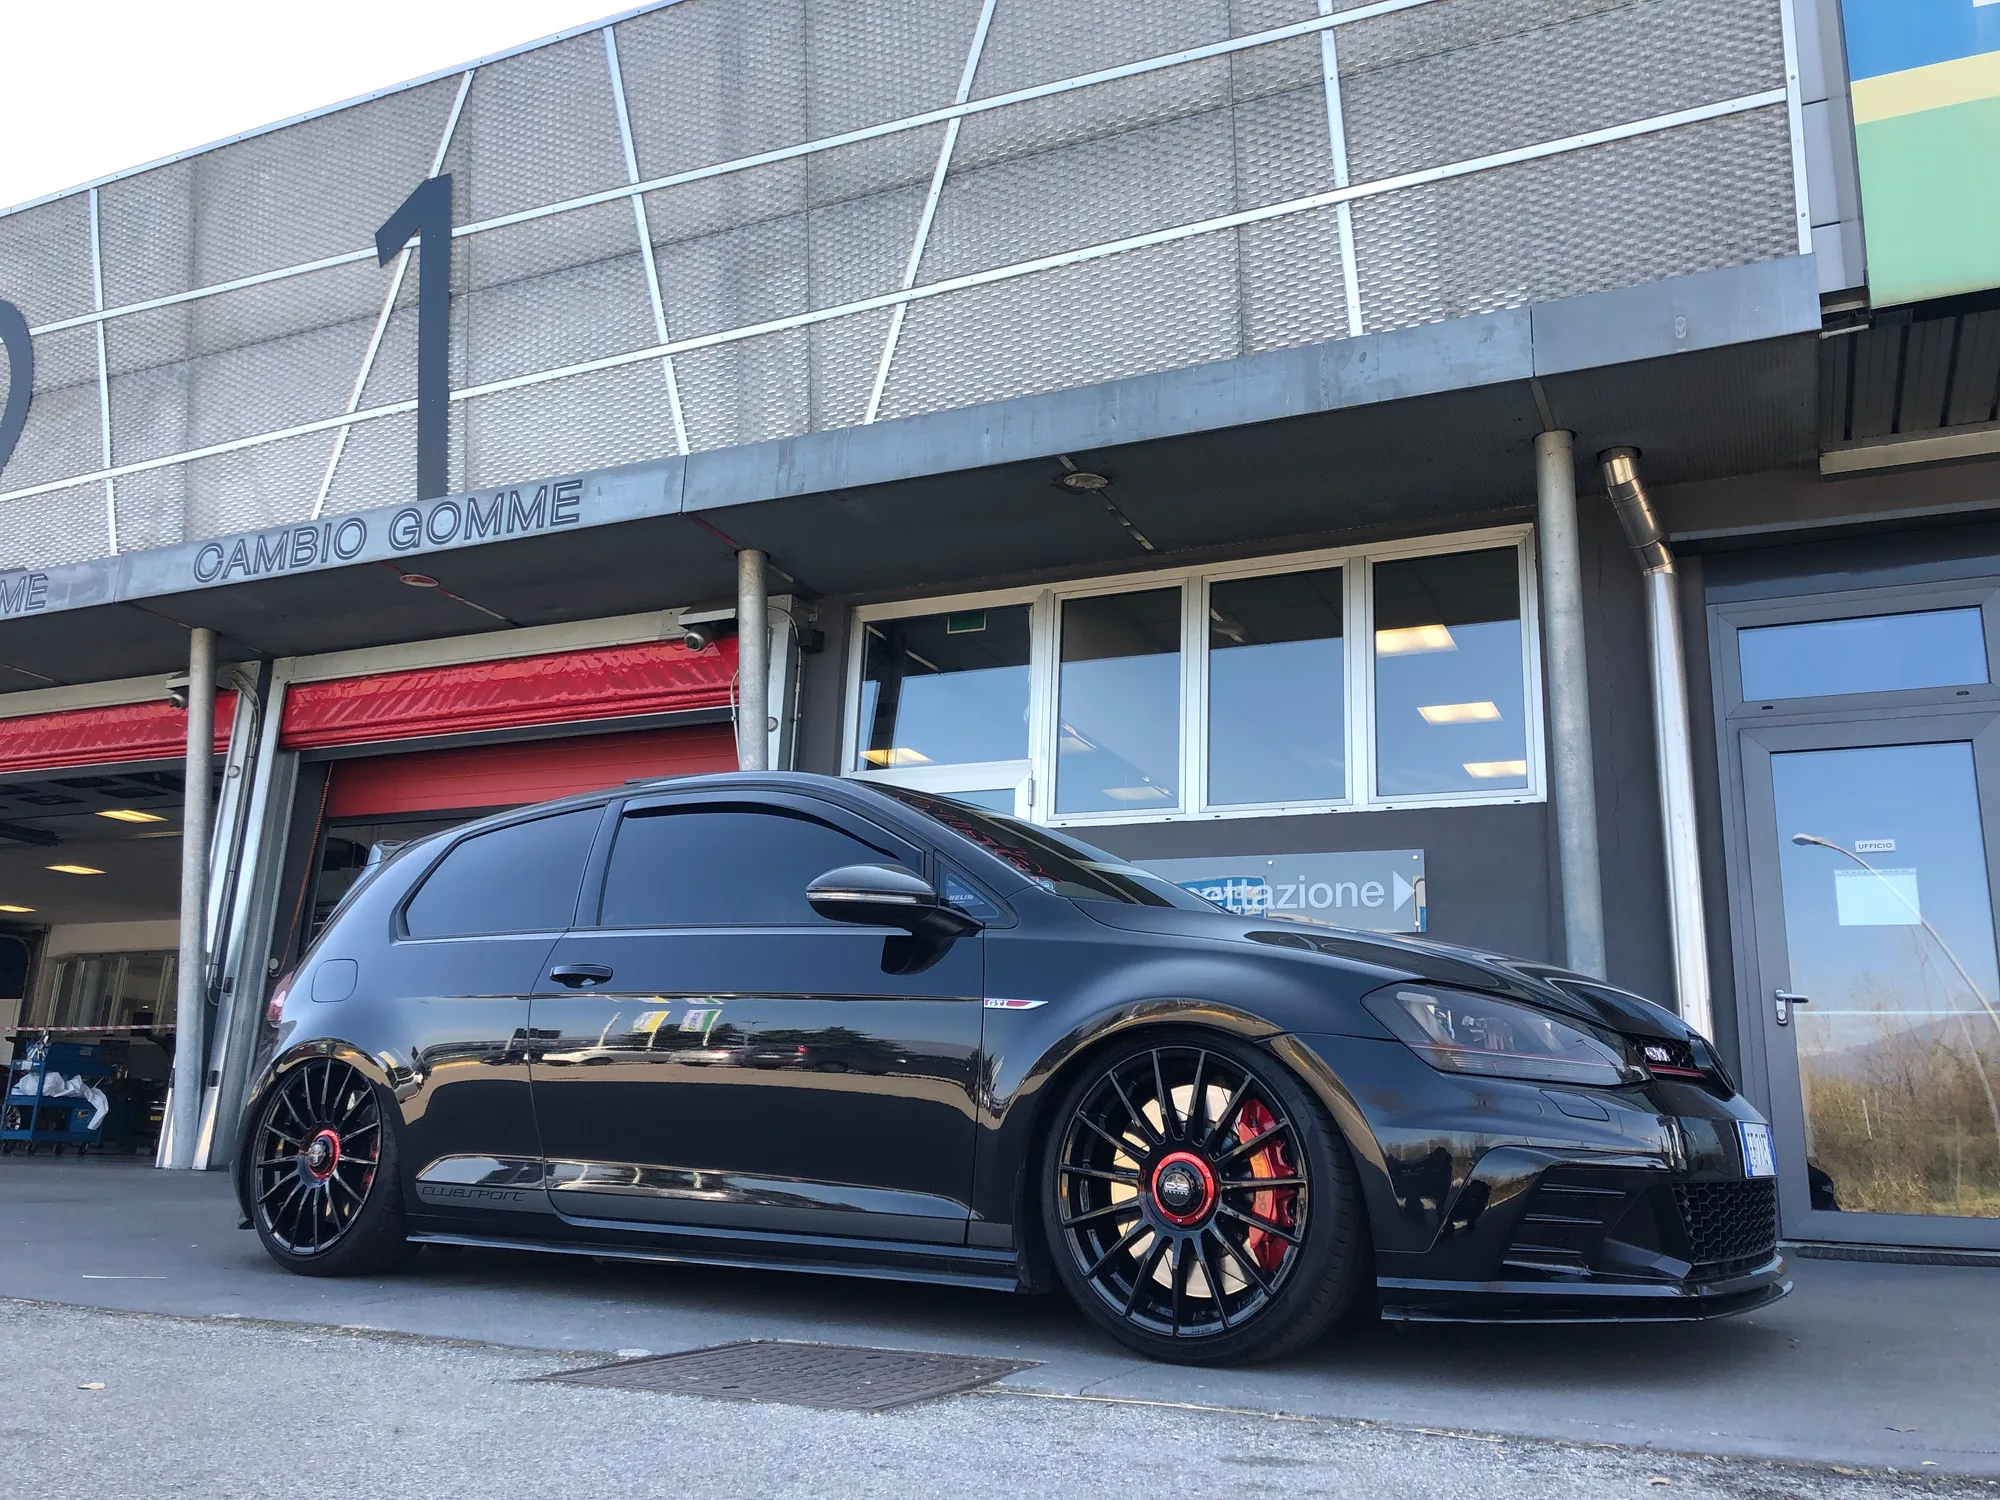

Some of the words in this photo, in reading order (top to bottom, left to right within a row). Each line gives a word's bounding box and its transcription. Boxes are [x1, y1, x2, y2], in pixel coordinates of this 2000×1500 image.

[375, 173, 452, 500] 1
[194, 518, 366, 583] CAMBIO
[389, 481, 582, 550] GOMME
[1858, 842, 1893, 850] UFFICIO
[1187, 876, 1385, 909] ettazione
